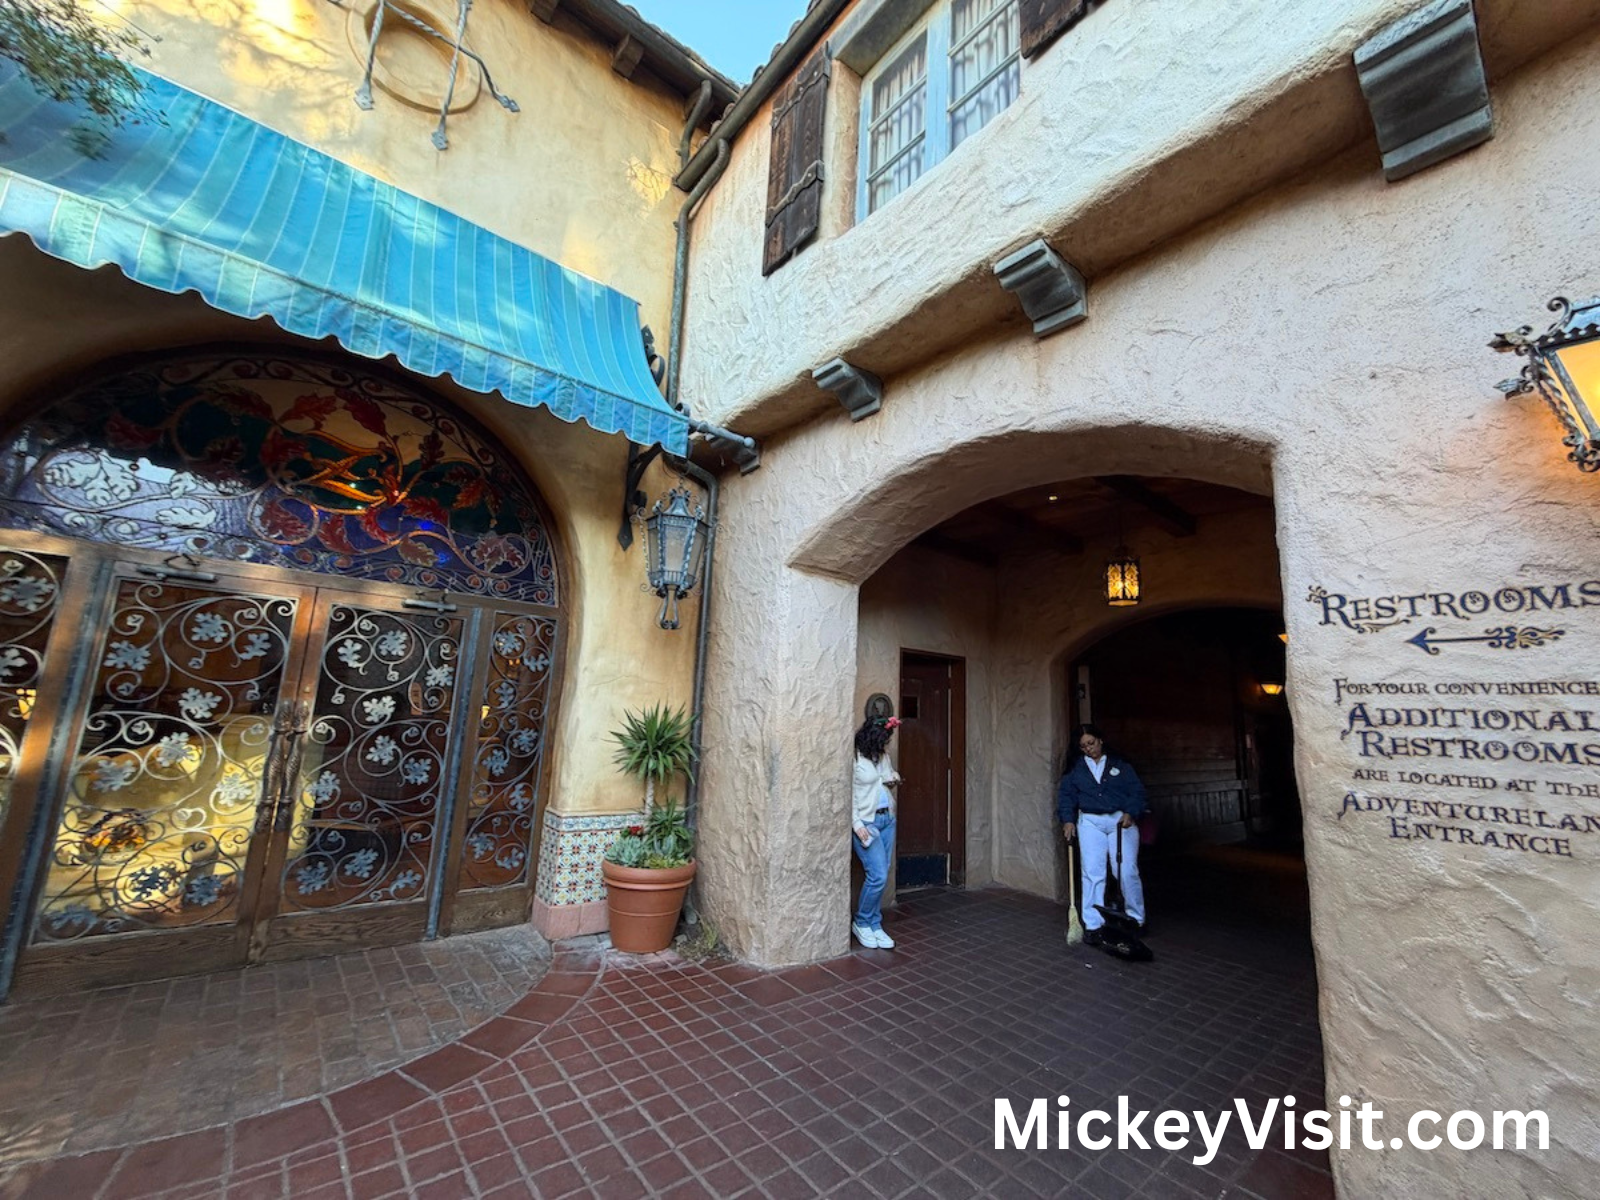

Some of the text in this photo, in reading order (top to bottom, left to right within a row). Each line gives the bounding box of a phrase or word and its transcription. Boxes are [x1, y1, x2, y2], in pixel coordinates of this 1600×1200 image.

[1318, 581, 1600, 634] RESTROOMS
[1333, 678, 1600, 706] FOR YOUR CONVENIENCE
[1340, 702, 1600, 740] ADDITIONAL
[1356, 730, 1600, 766] RESTROOMS
[1352, 769, 1389, 782] ARE
[1398, 771, 1497, 790] LOCATED
[1505, 779, 1536, 793] AT
[1387, 816, 1573, 857] ENTRANCE
